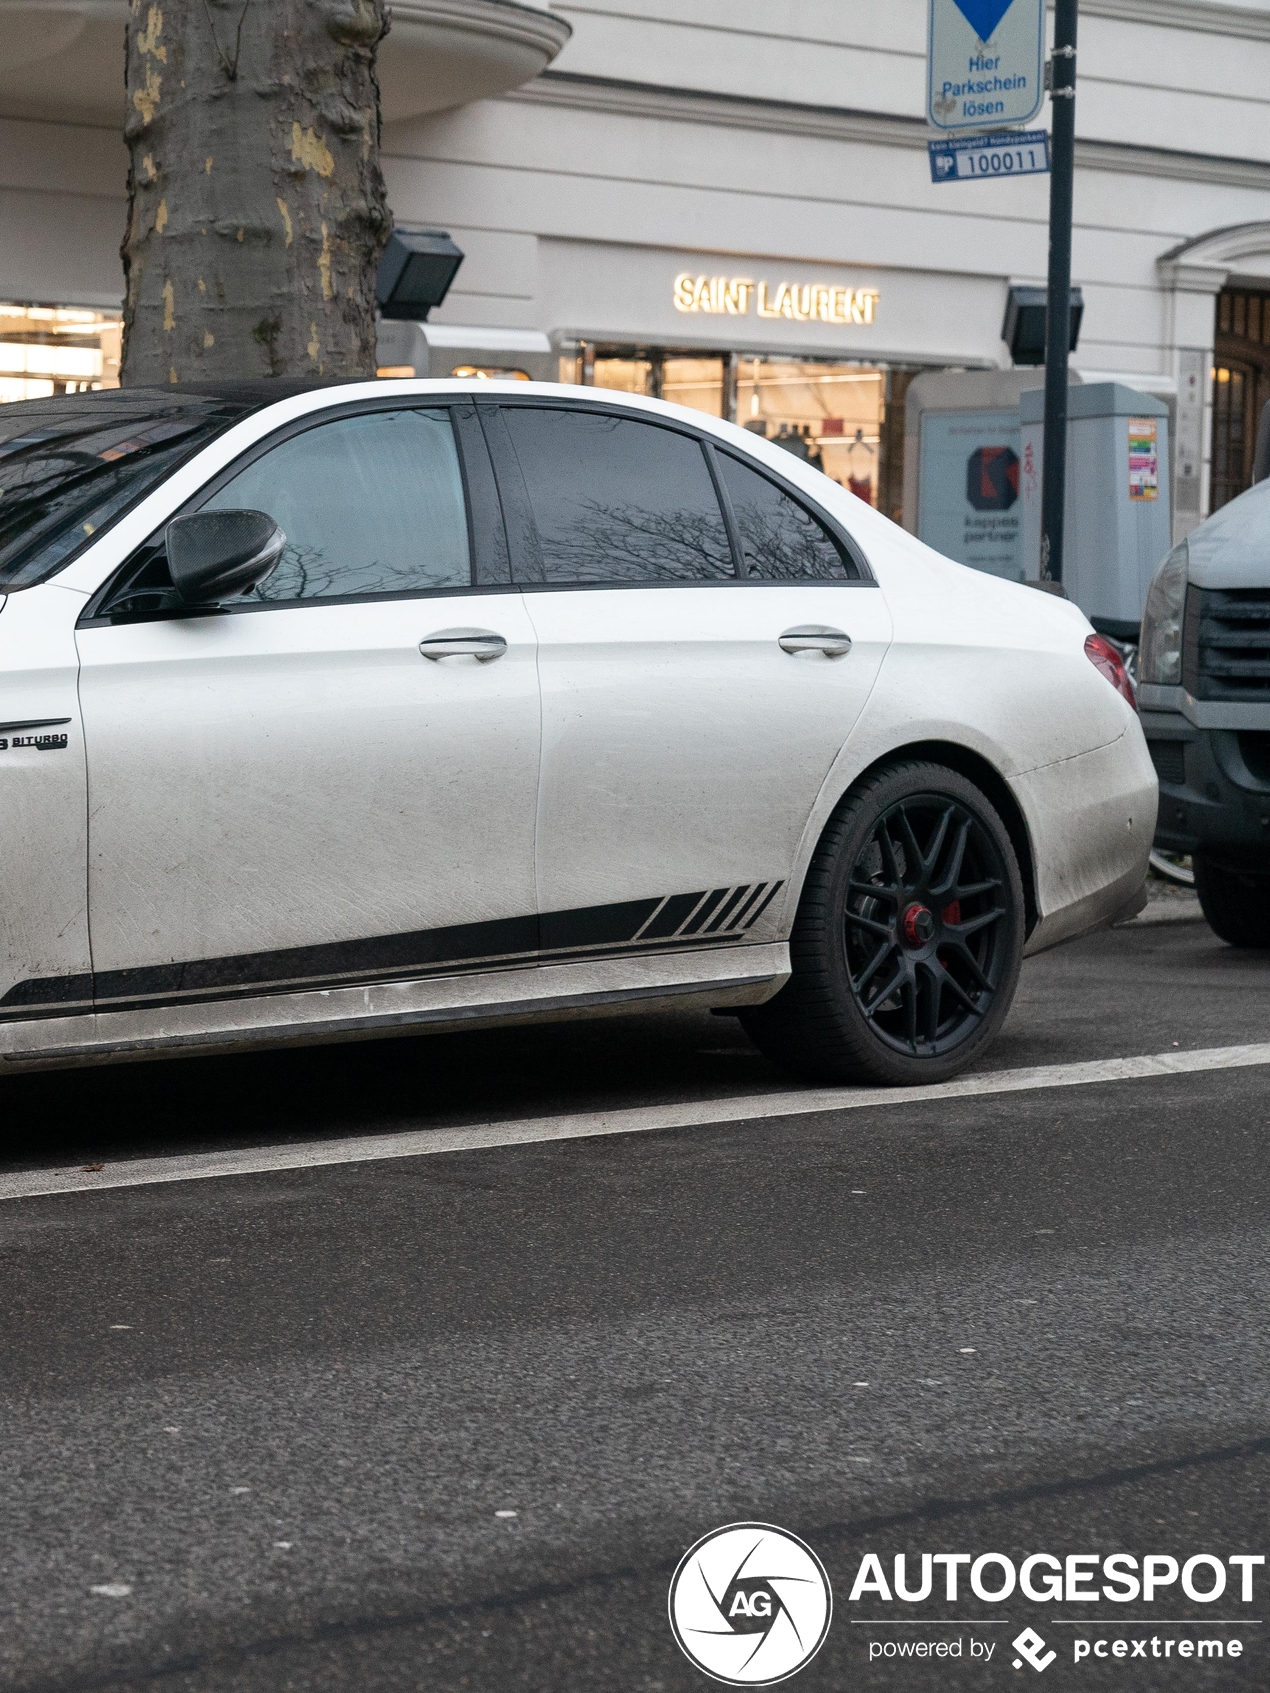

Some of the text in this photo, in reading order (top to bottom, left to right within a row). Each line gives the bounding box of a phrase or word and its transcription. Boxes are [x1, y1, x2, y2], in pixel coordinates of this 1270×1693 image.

[968, 56, 1000, 72] Hier
[942, 73, 1027, 98] Parkschein
[963, 100, 1005, 117] lösen
[968, 150, 1036, 173] 100011
[674, 273, 881, 325] SAINT LAURENT
[11, 733, 68, 747] BITURBO
